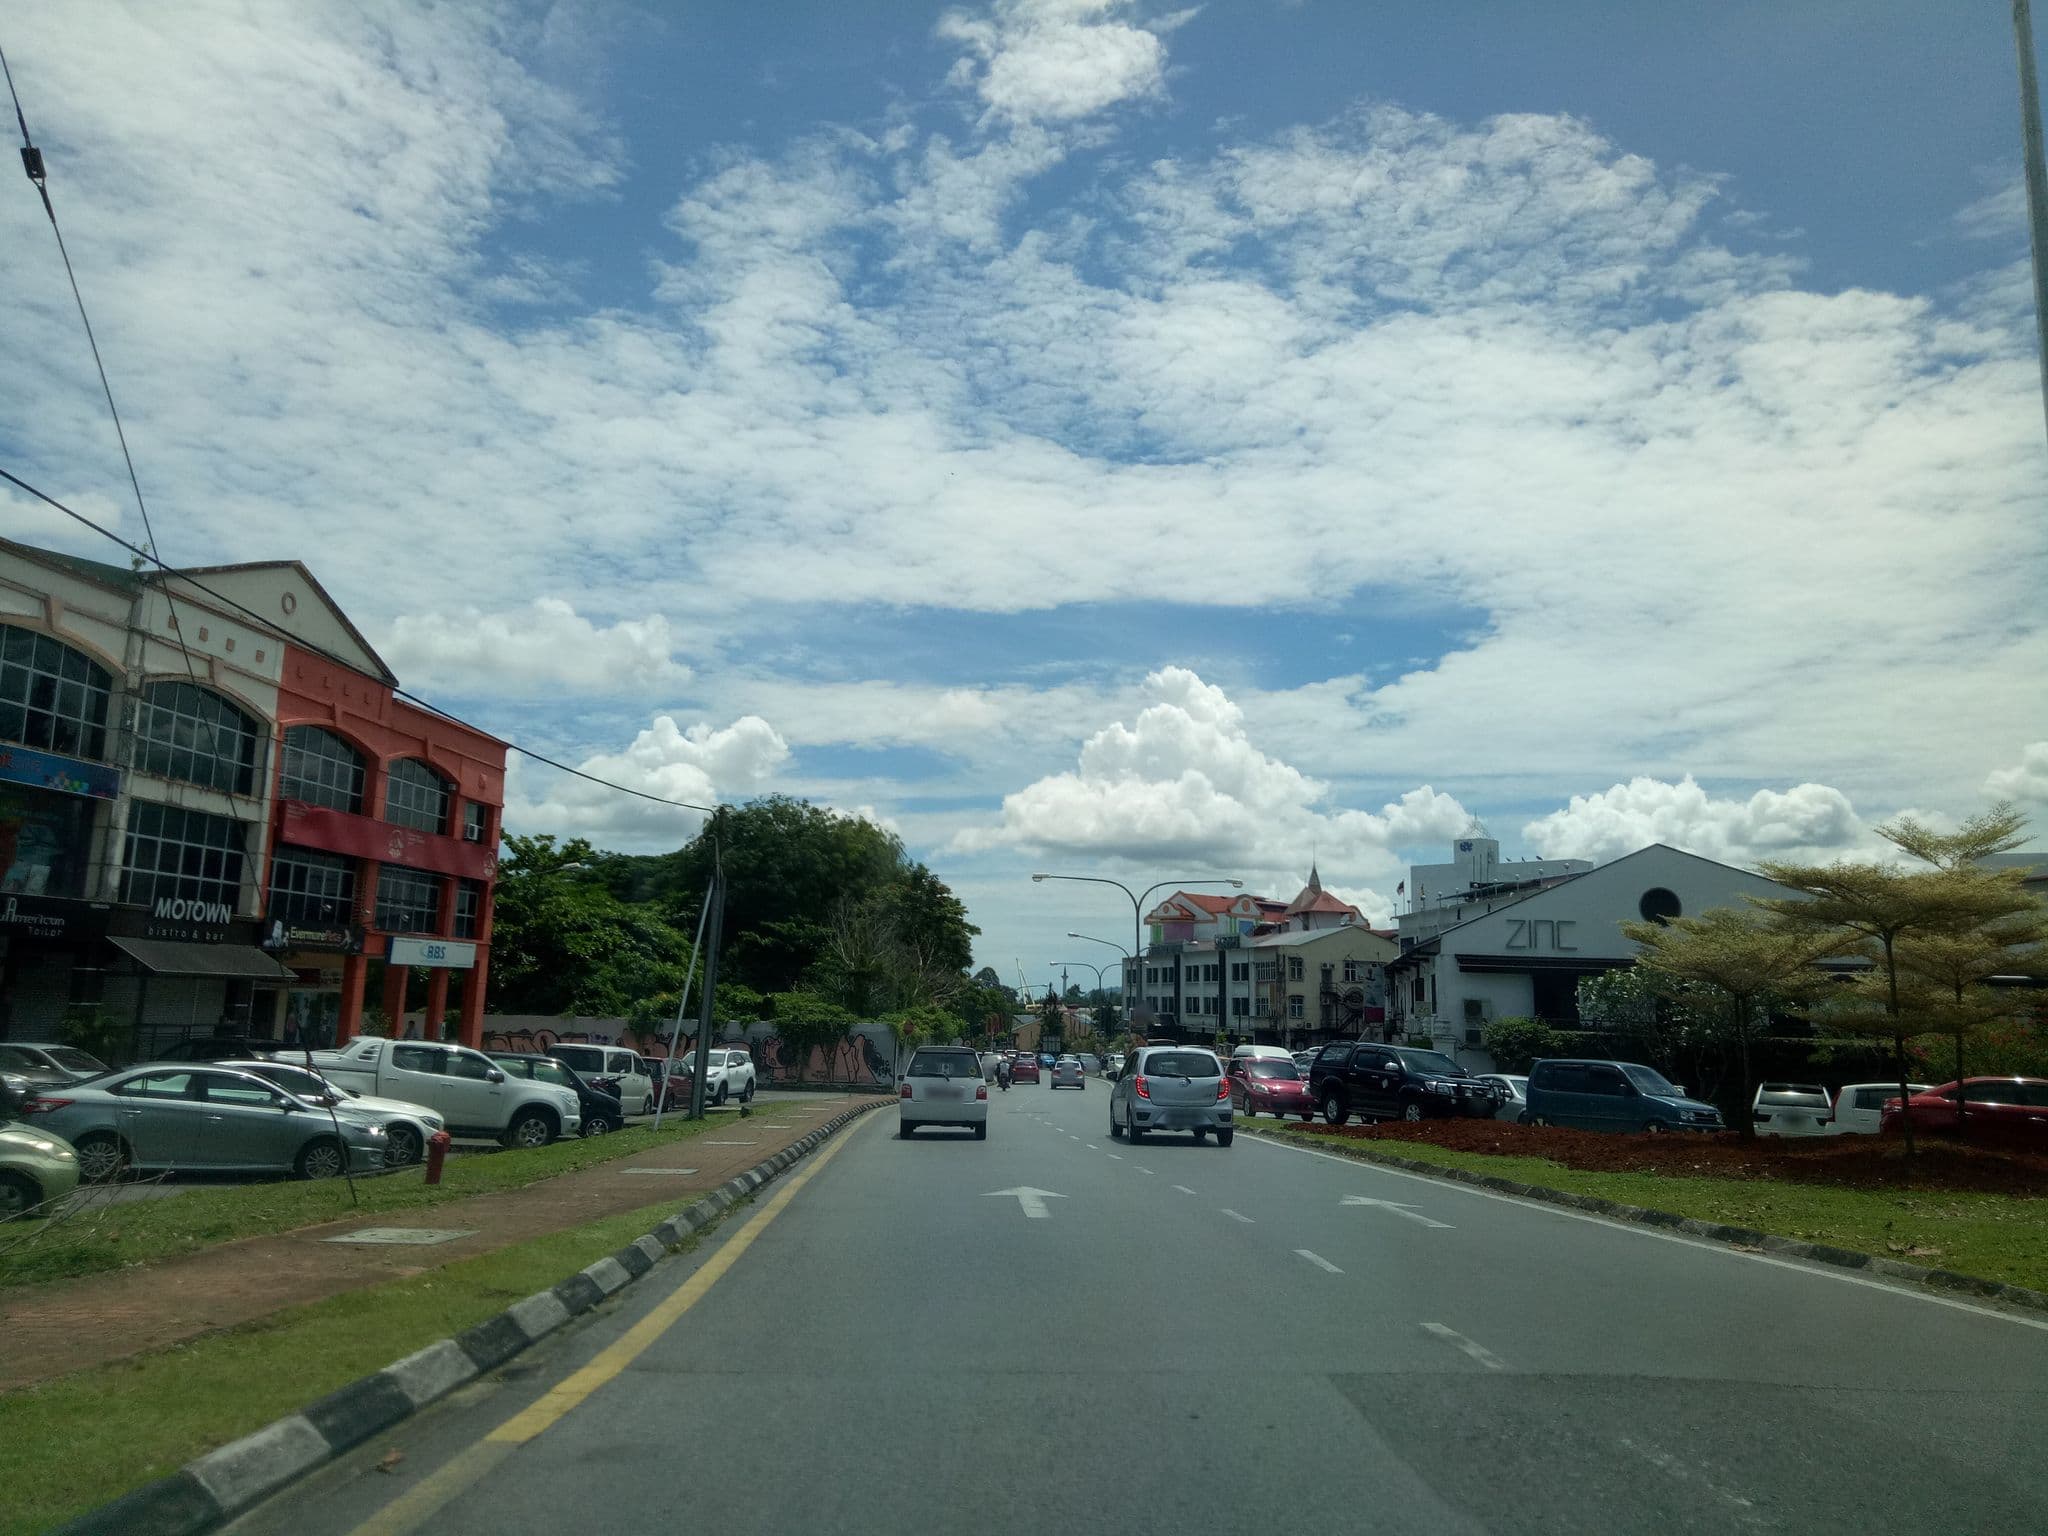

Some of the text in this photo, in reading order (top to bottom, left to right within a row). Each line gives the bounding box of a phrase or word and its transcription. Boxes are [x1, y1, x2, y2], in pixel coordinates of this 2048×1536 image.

[155, 897, 232, 924] MOTOWN
[148, 926, 187, 938] bistro
[206, 930, 225, 941] bar
[426, 944, 447, 960] BBS
